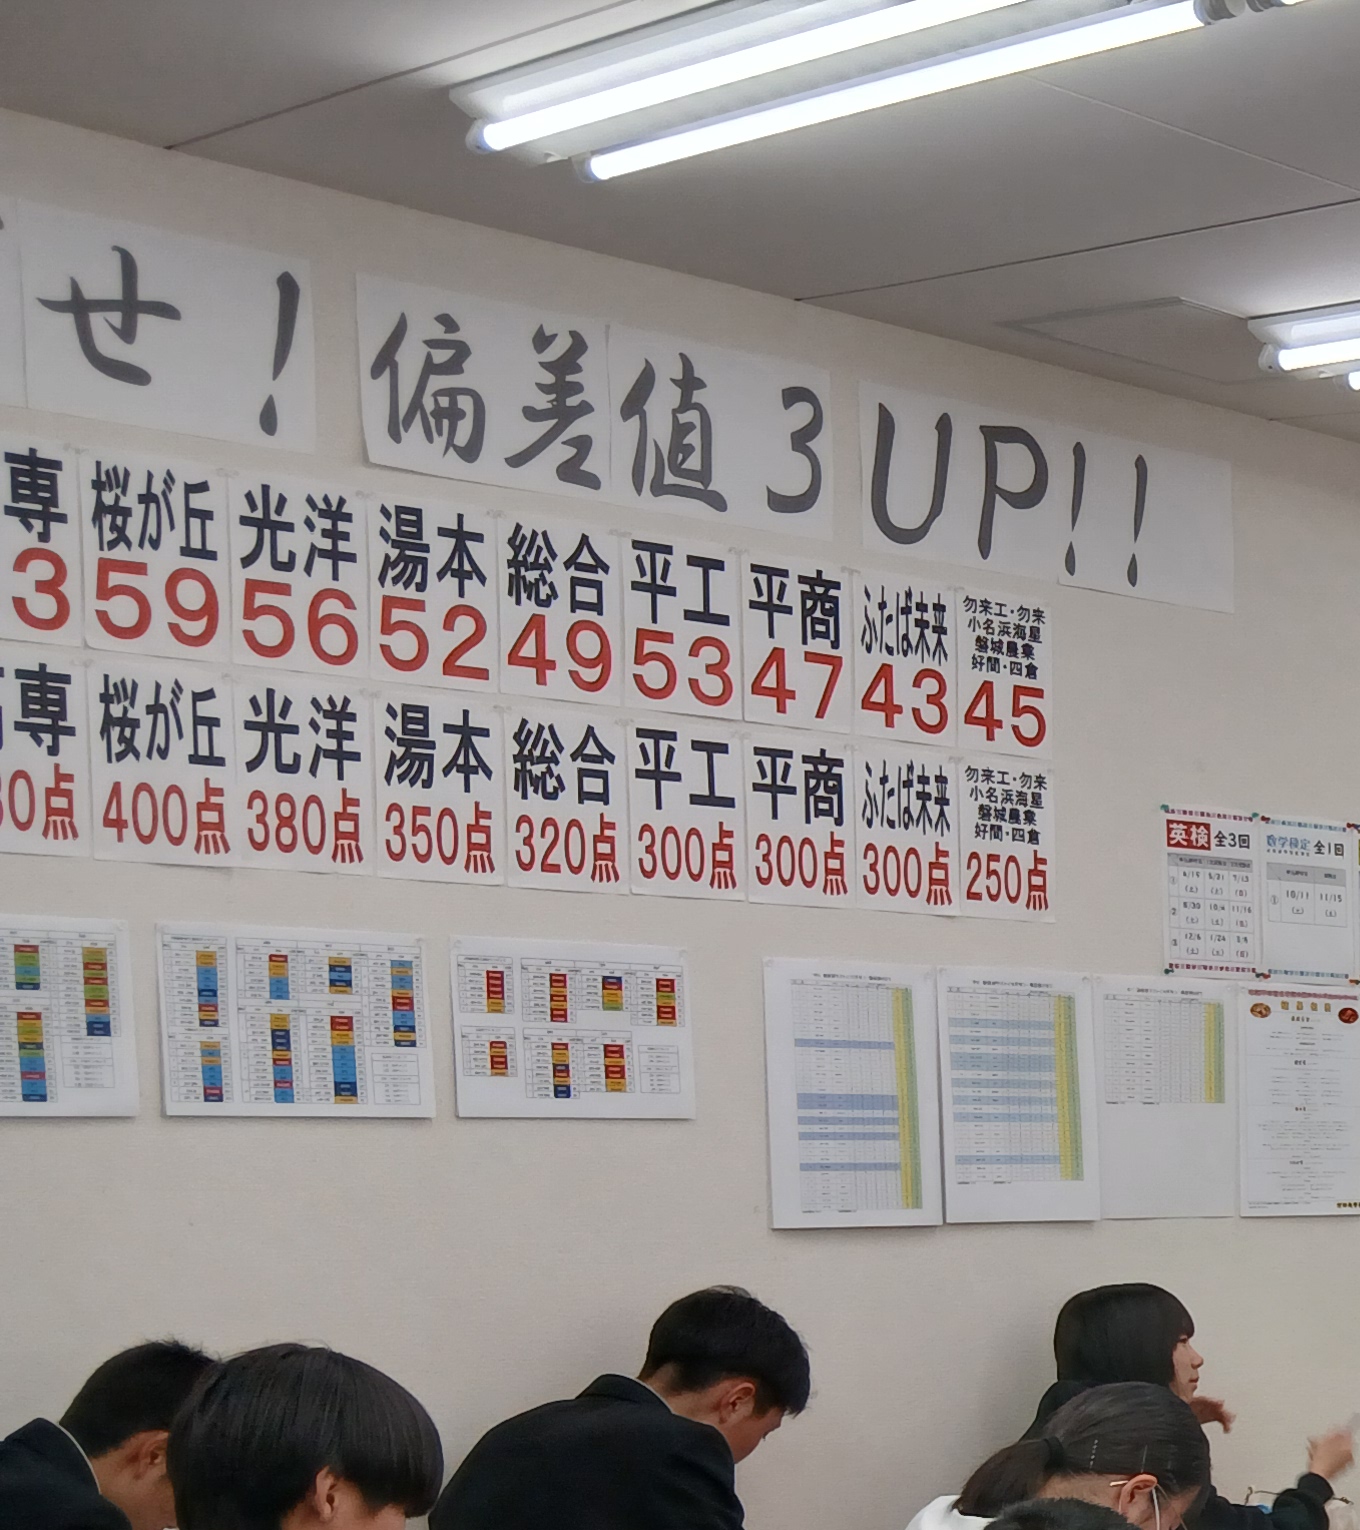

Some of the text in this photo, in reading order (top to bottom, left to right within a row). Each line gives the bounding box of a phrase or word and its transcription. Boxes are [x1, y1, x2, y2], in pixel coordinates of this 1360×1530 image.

[3, 447, 948, 666] 専 桜が丘 光洋 湯本 総合 平工 平商 ふたば未来
[963, 595, 1046, 625] 勿来工・勿来
[968, 616, 1042, 644] 小名浜海星
[12, 547, 1046, 747] 3 59 56 52 49 53 47 43 45
[975, 635, 1035, 660] 磐城農業
[972, 654, 1038, 680] 好間・四倉
[0, 663, 950, 837] 専 桜が丘 光洋 湯本 総合 平工 平商 ふたば未来
[965, 766, 1047, 791] 勿来工・勿来
[970, 786, 1044, 809] 小名浜海星
[0, 763, 1048, 911] 0点 400点 380点 350点 320点 300点 300点 300点 250点
[975, 823, 1040, 845] 好間・四倉
[1169, 823, 1250, 849] 英検 全3回
[1313, 840, 1345, 857] 全1回
